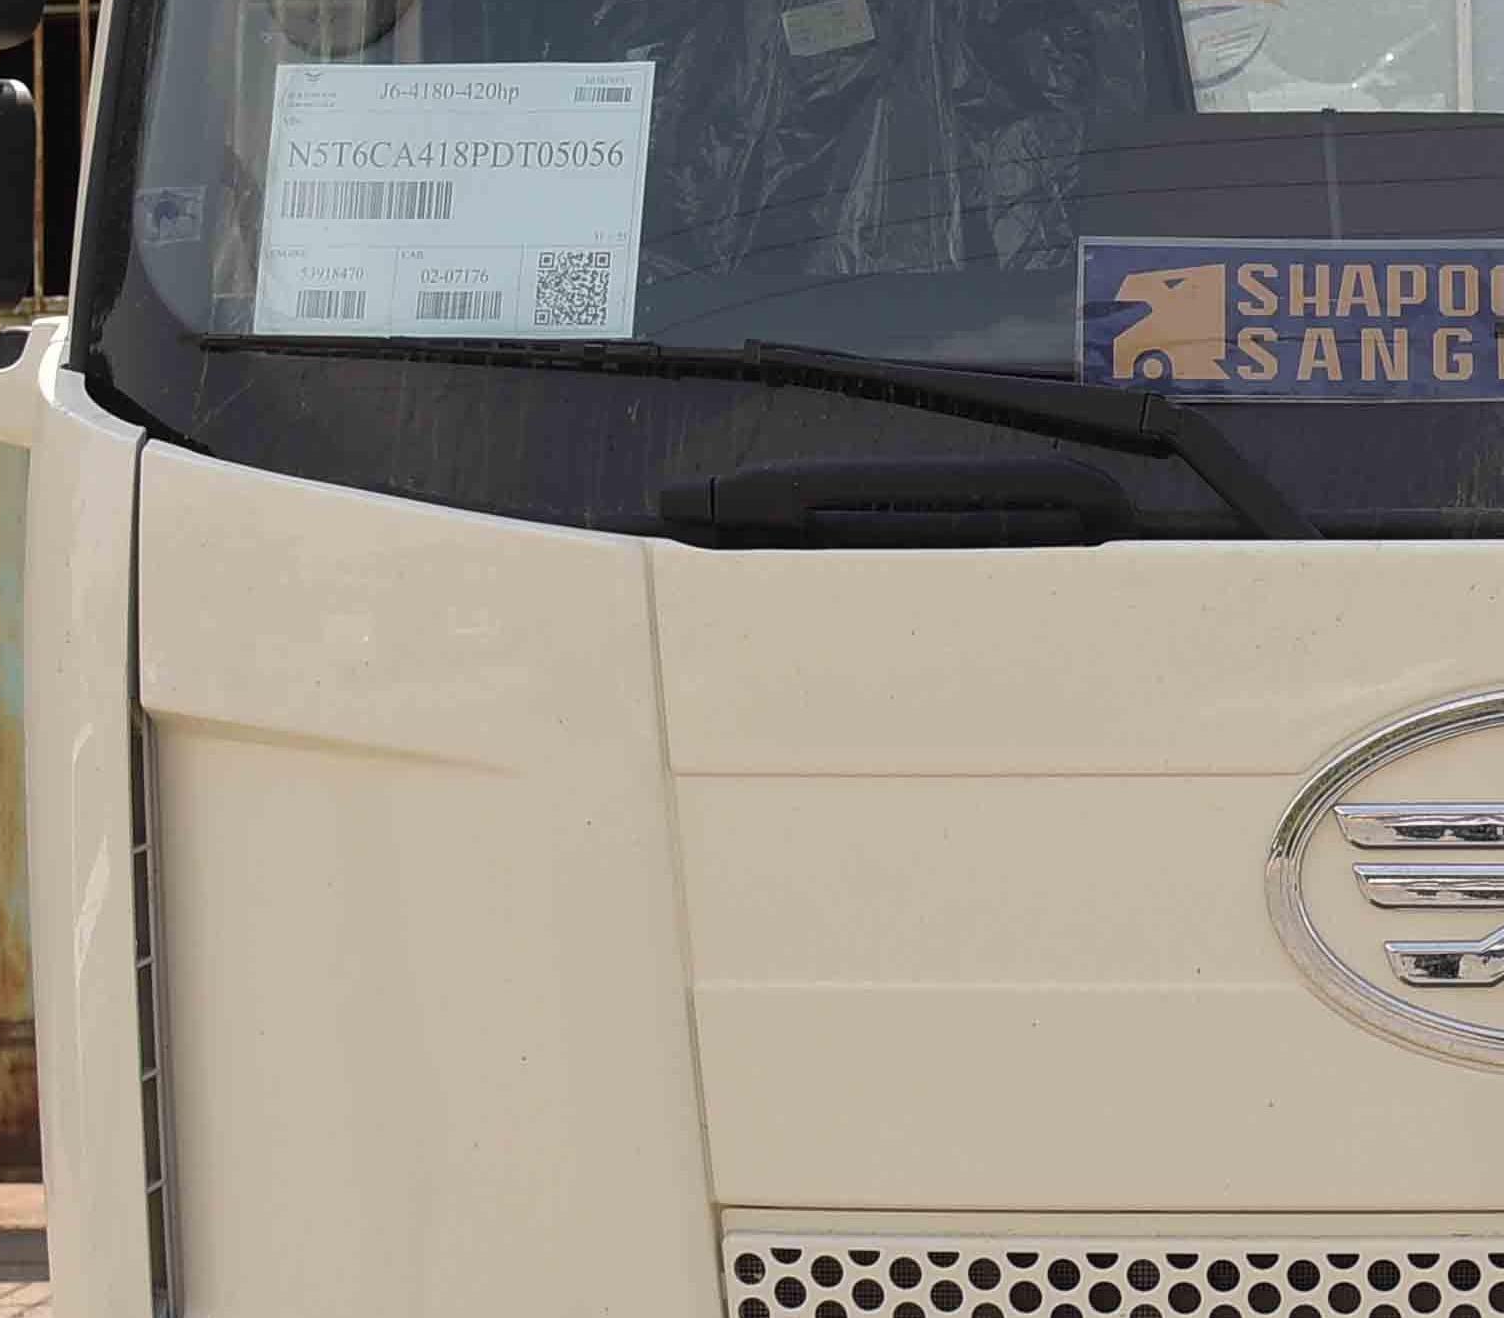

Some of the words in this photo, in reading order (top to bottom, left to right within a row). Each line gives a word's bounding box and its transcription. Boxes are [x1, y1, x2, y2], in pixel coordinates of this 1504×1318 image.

[380, 82, 520, 105] J6-4180-420hp
[287, 140, 625, 170] N5T6CA418PDT05056
[421, 268, 489, 285] 02-07176
